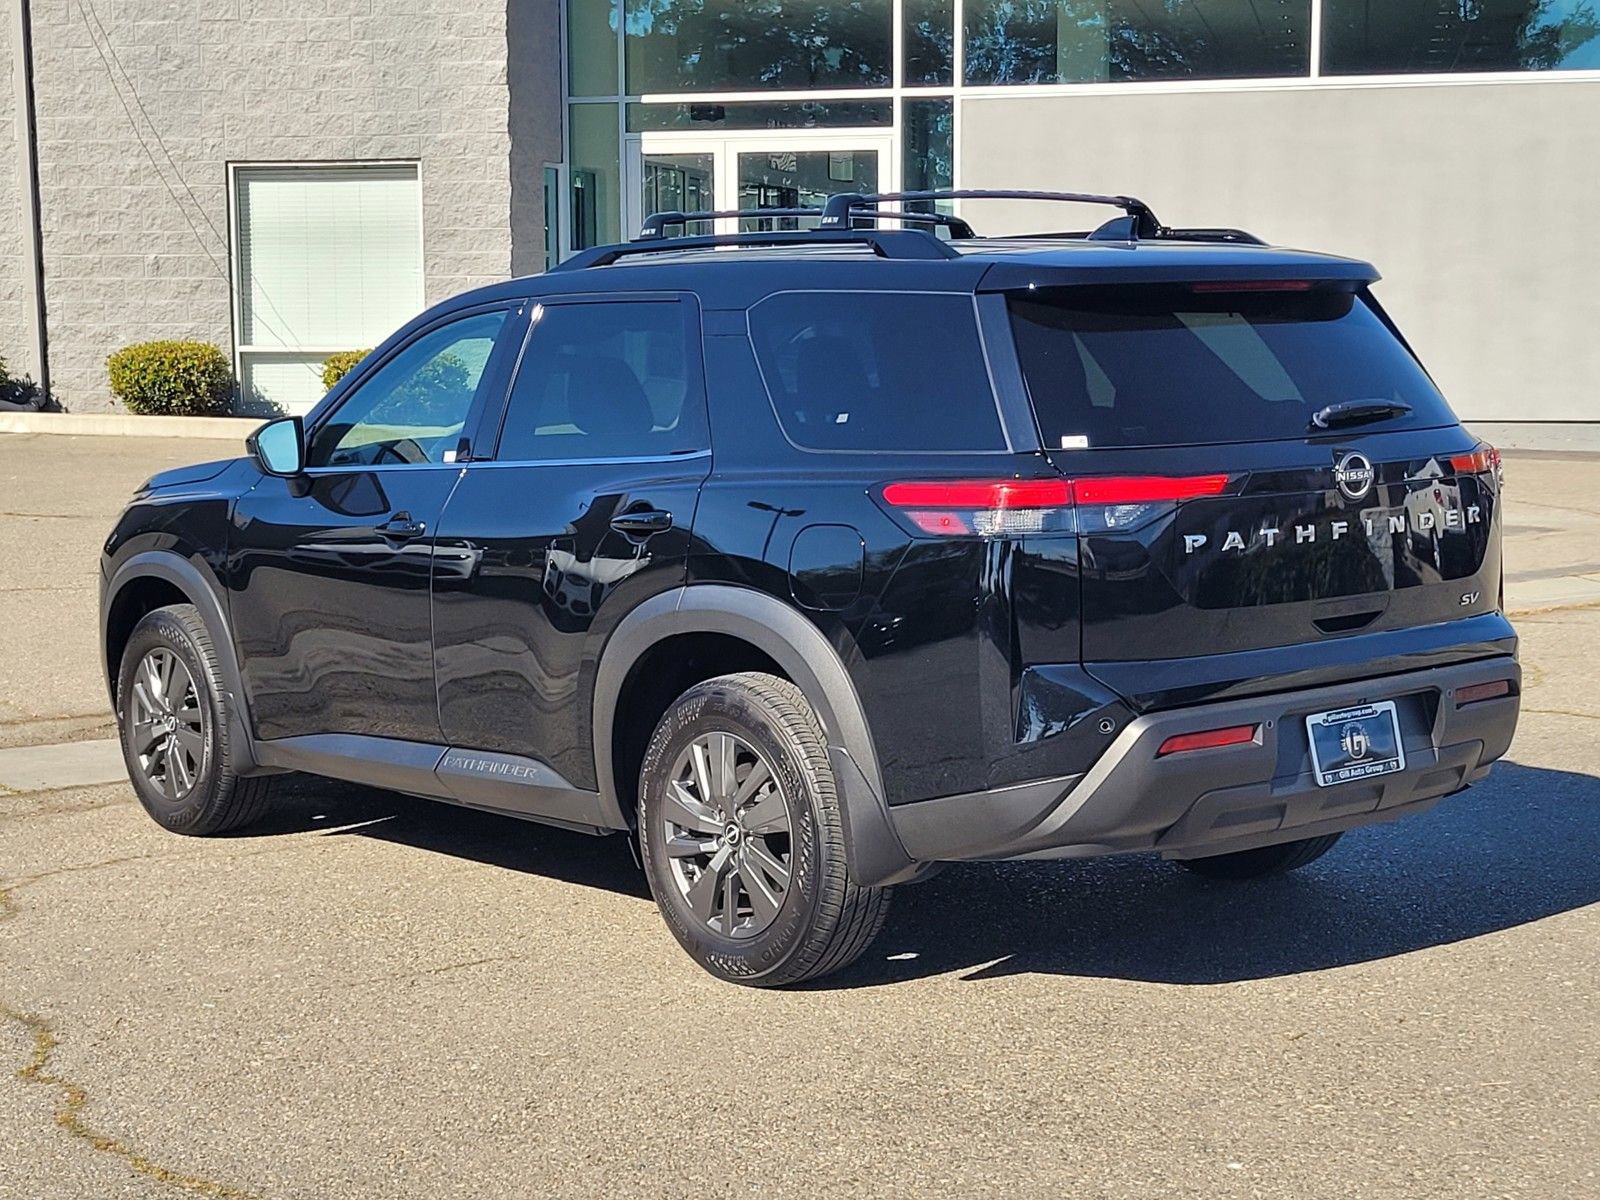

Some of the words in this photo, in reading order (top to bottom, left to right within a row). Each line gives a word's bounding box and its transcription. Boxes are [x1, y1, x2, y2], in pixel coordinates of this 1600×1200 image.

[1184, 505, 1481, 554] PATHFINDER
[1460, 592, 1480, 606] SV
[443, 757, 538, 779] PATHFINDER
[1351, 767, 1364, 776] Auto
[1365, 764, 1384, 774] Group
